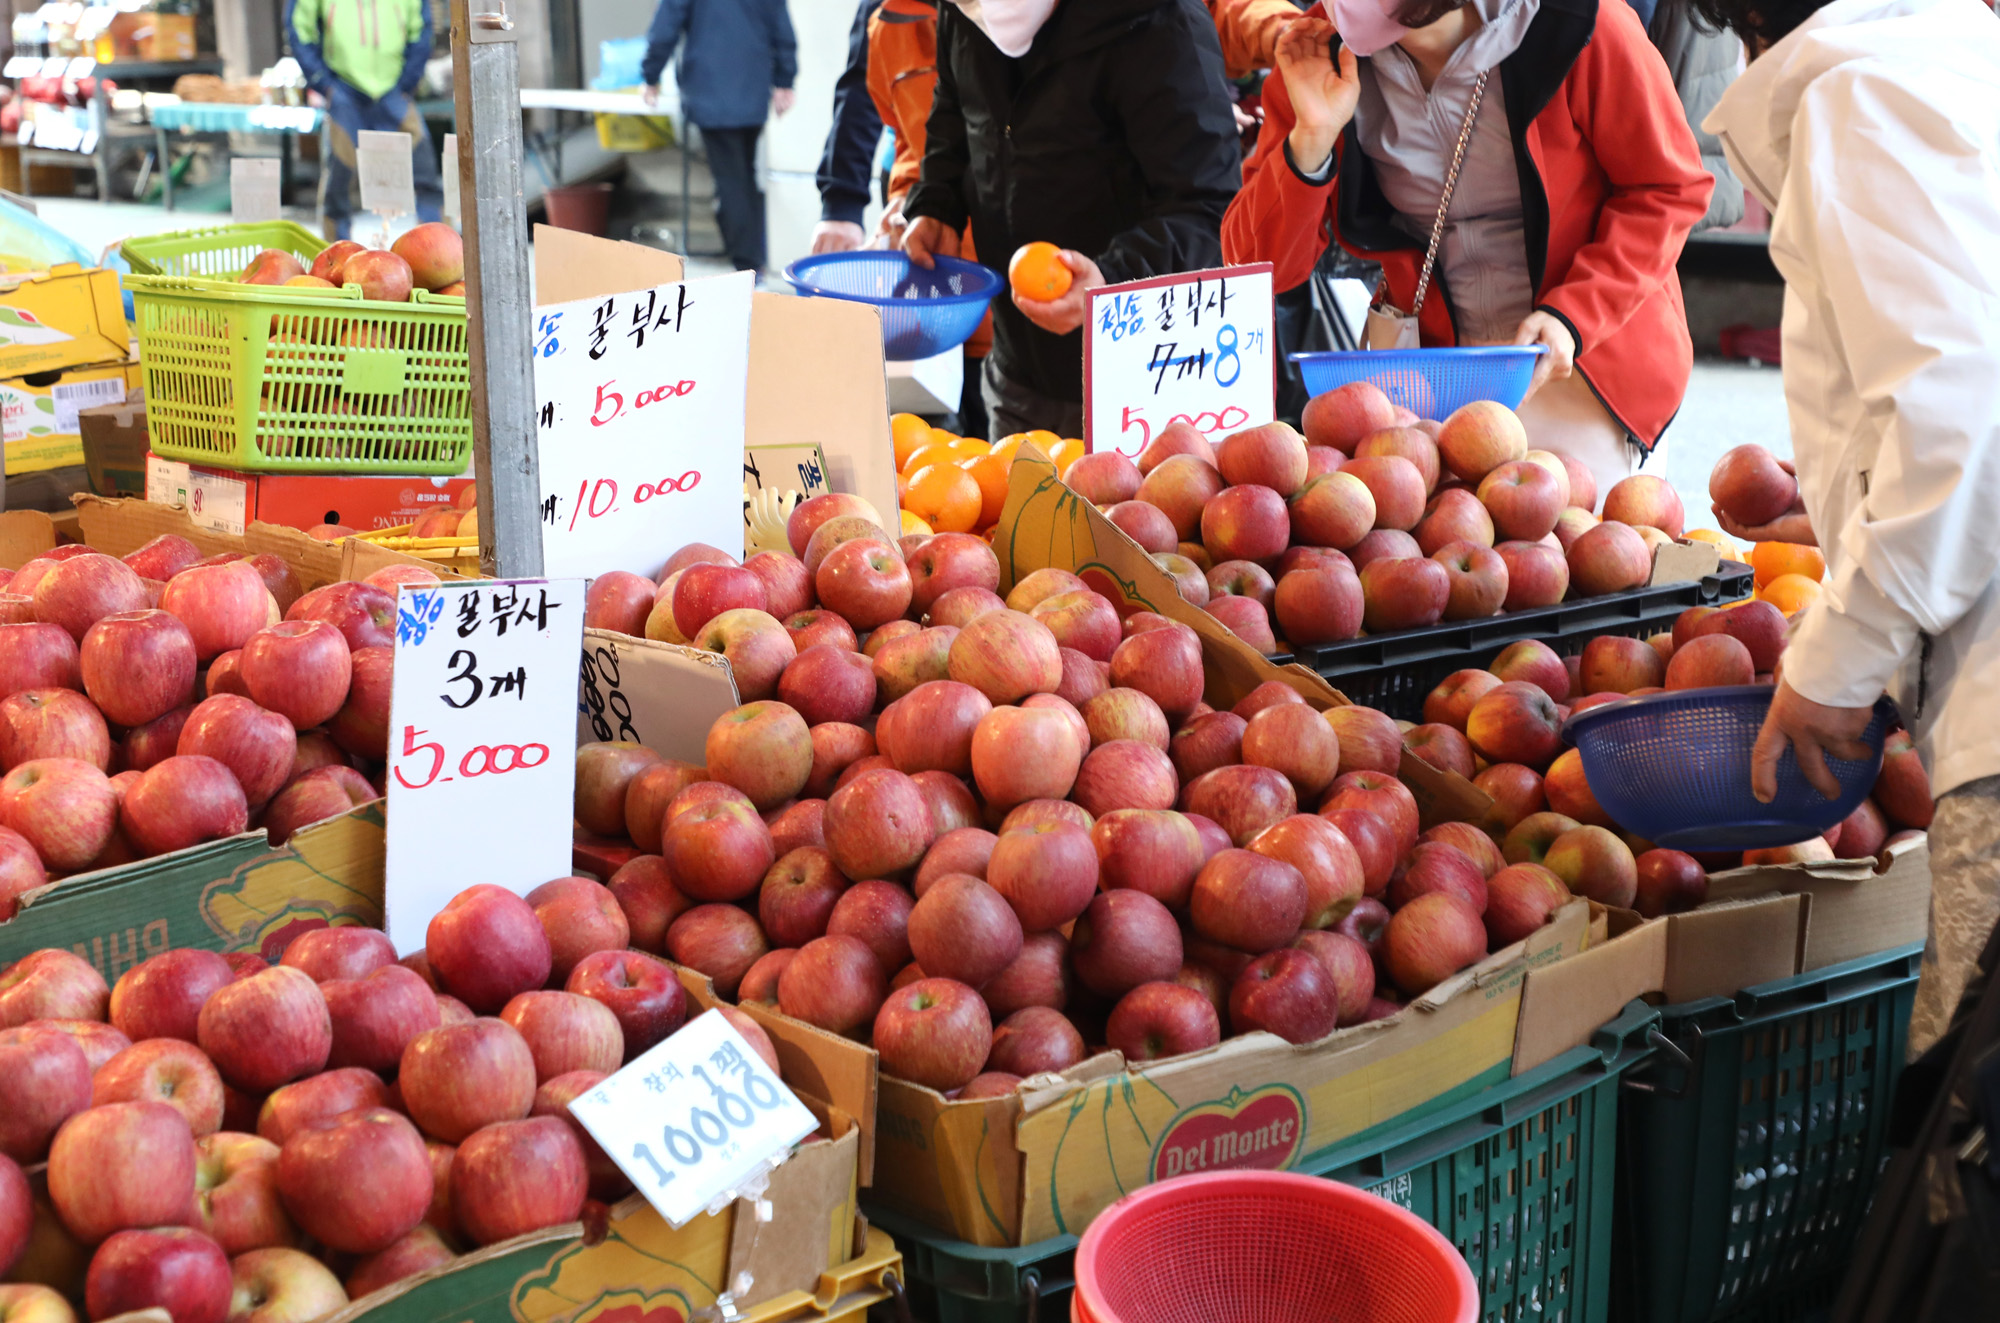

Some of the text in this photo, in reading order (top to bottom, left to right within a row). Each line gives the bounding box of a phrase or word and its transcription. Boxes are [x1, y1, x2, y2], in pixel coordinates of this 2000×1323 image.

[533, 312, 564, 358] 송
[627, 284, 695, 348] 부사
[489, 584, 563, 637] 부사
[1167, 1117, 1295, 1178] Del Monte
